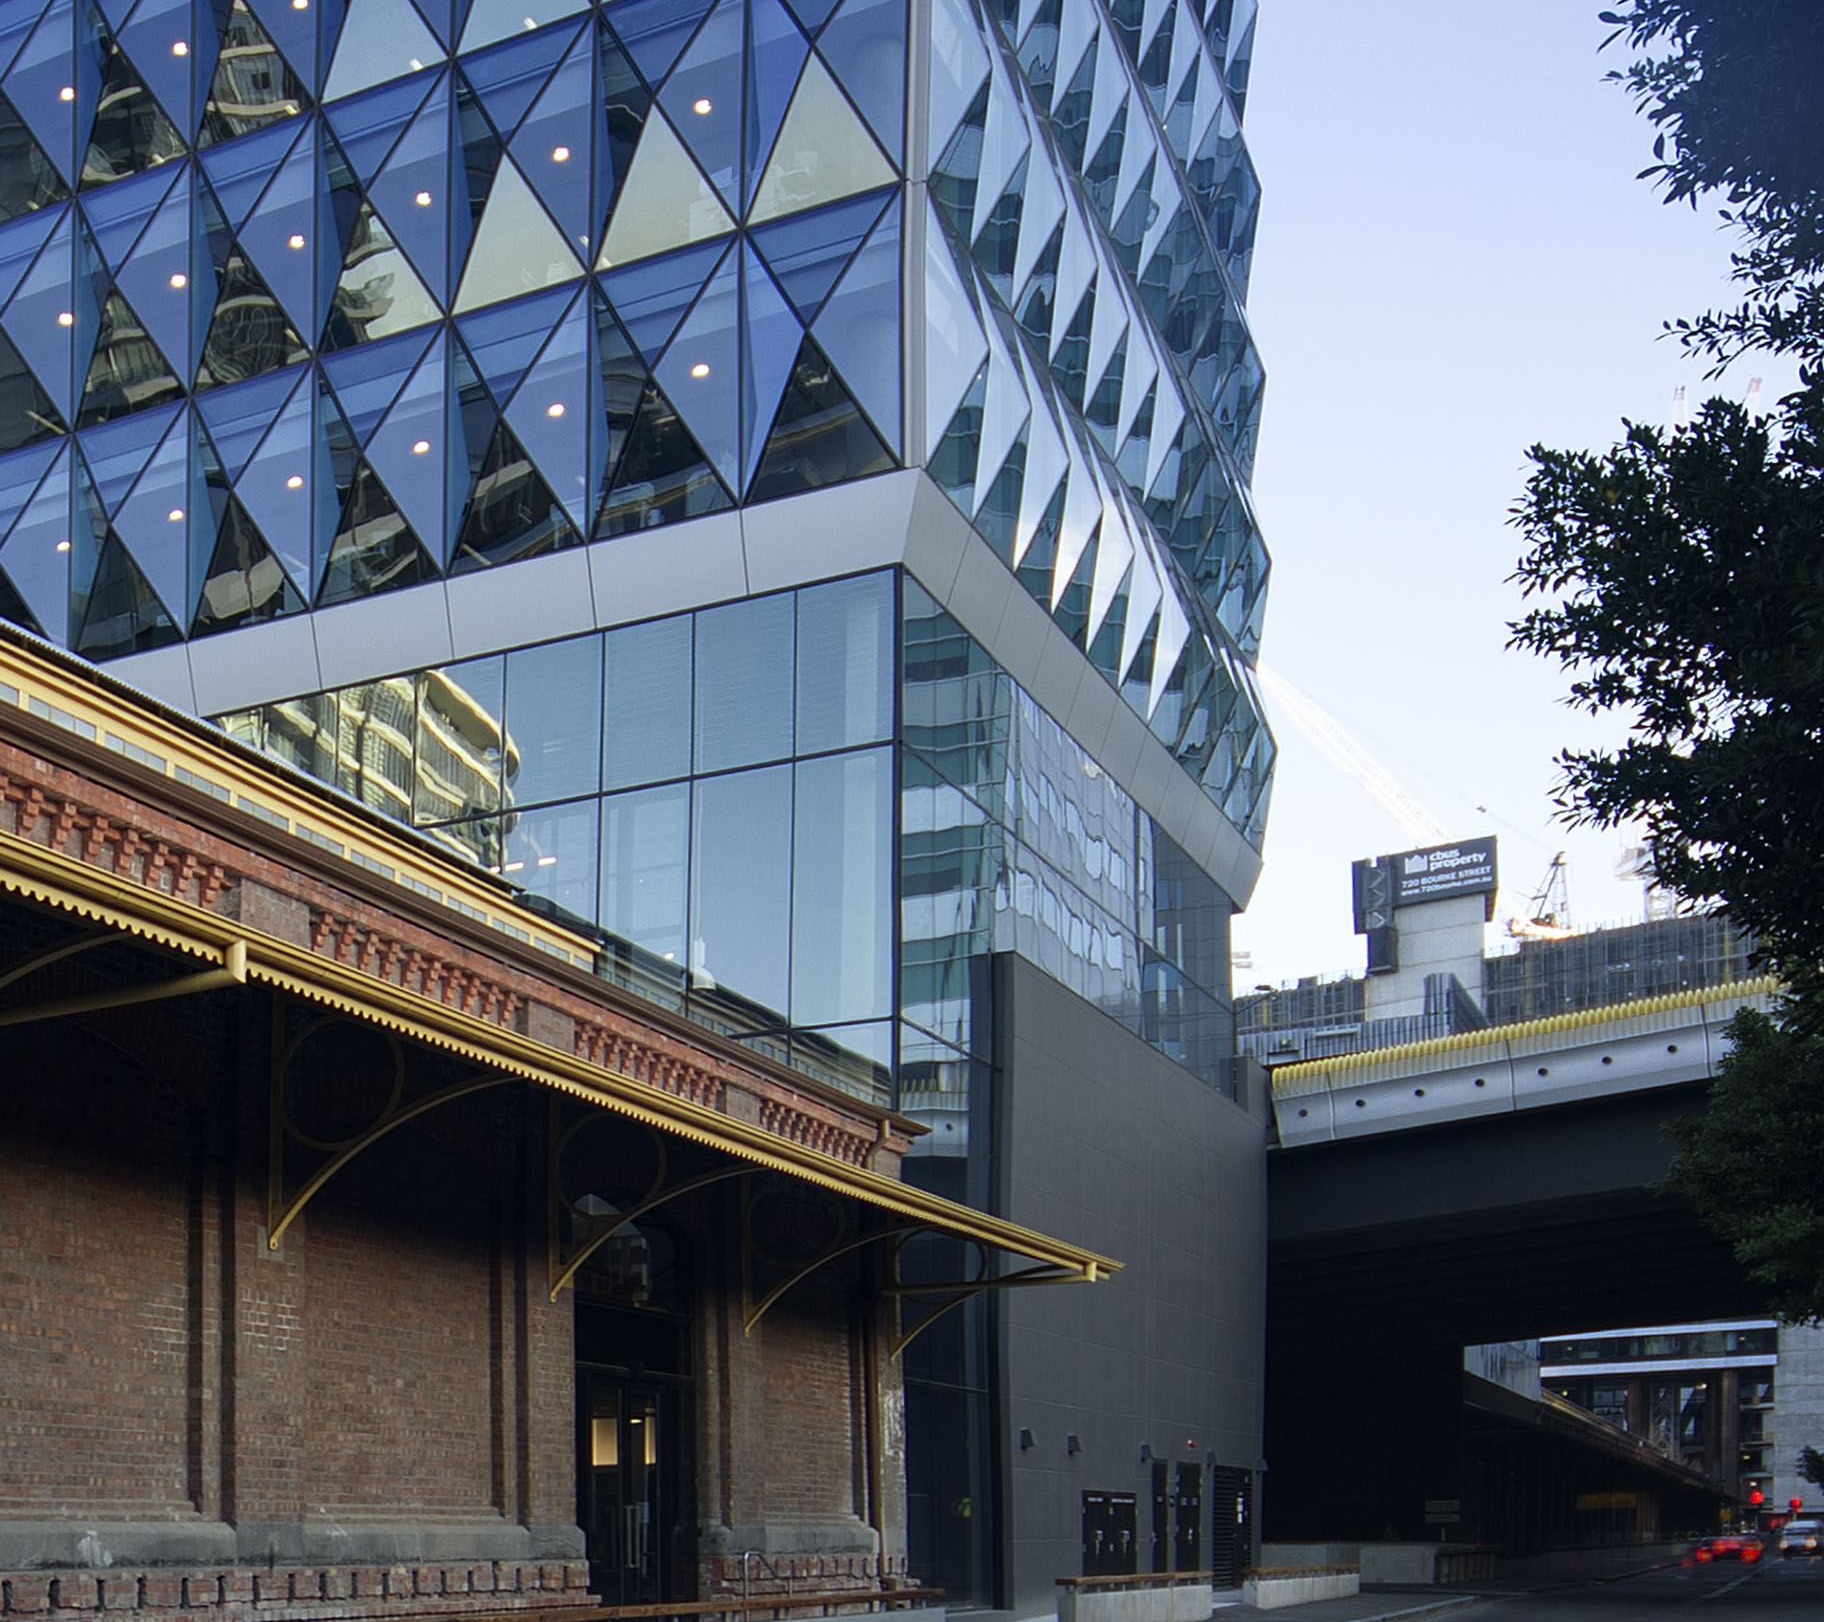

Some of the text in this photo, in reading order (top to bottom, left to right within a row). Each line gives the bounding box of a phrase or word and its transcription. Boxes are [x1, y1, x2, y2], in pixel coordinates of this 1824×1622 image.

[1429, 848, 1460, 861] cbus
[1429, 852, 1487, 871] property
[1401, 878, 1419, 889] 720
[1458, 865, 1492, 878] STREET
